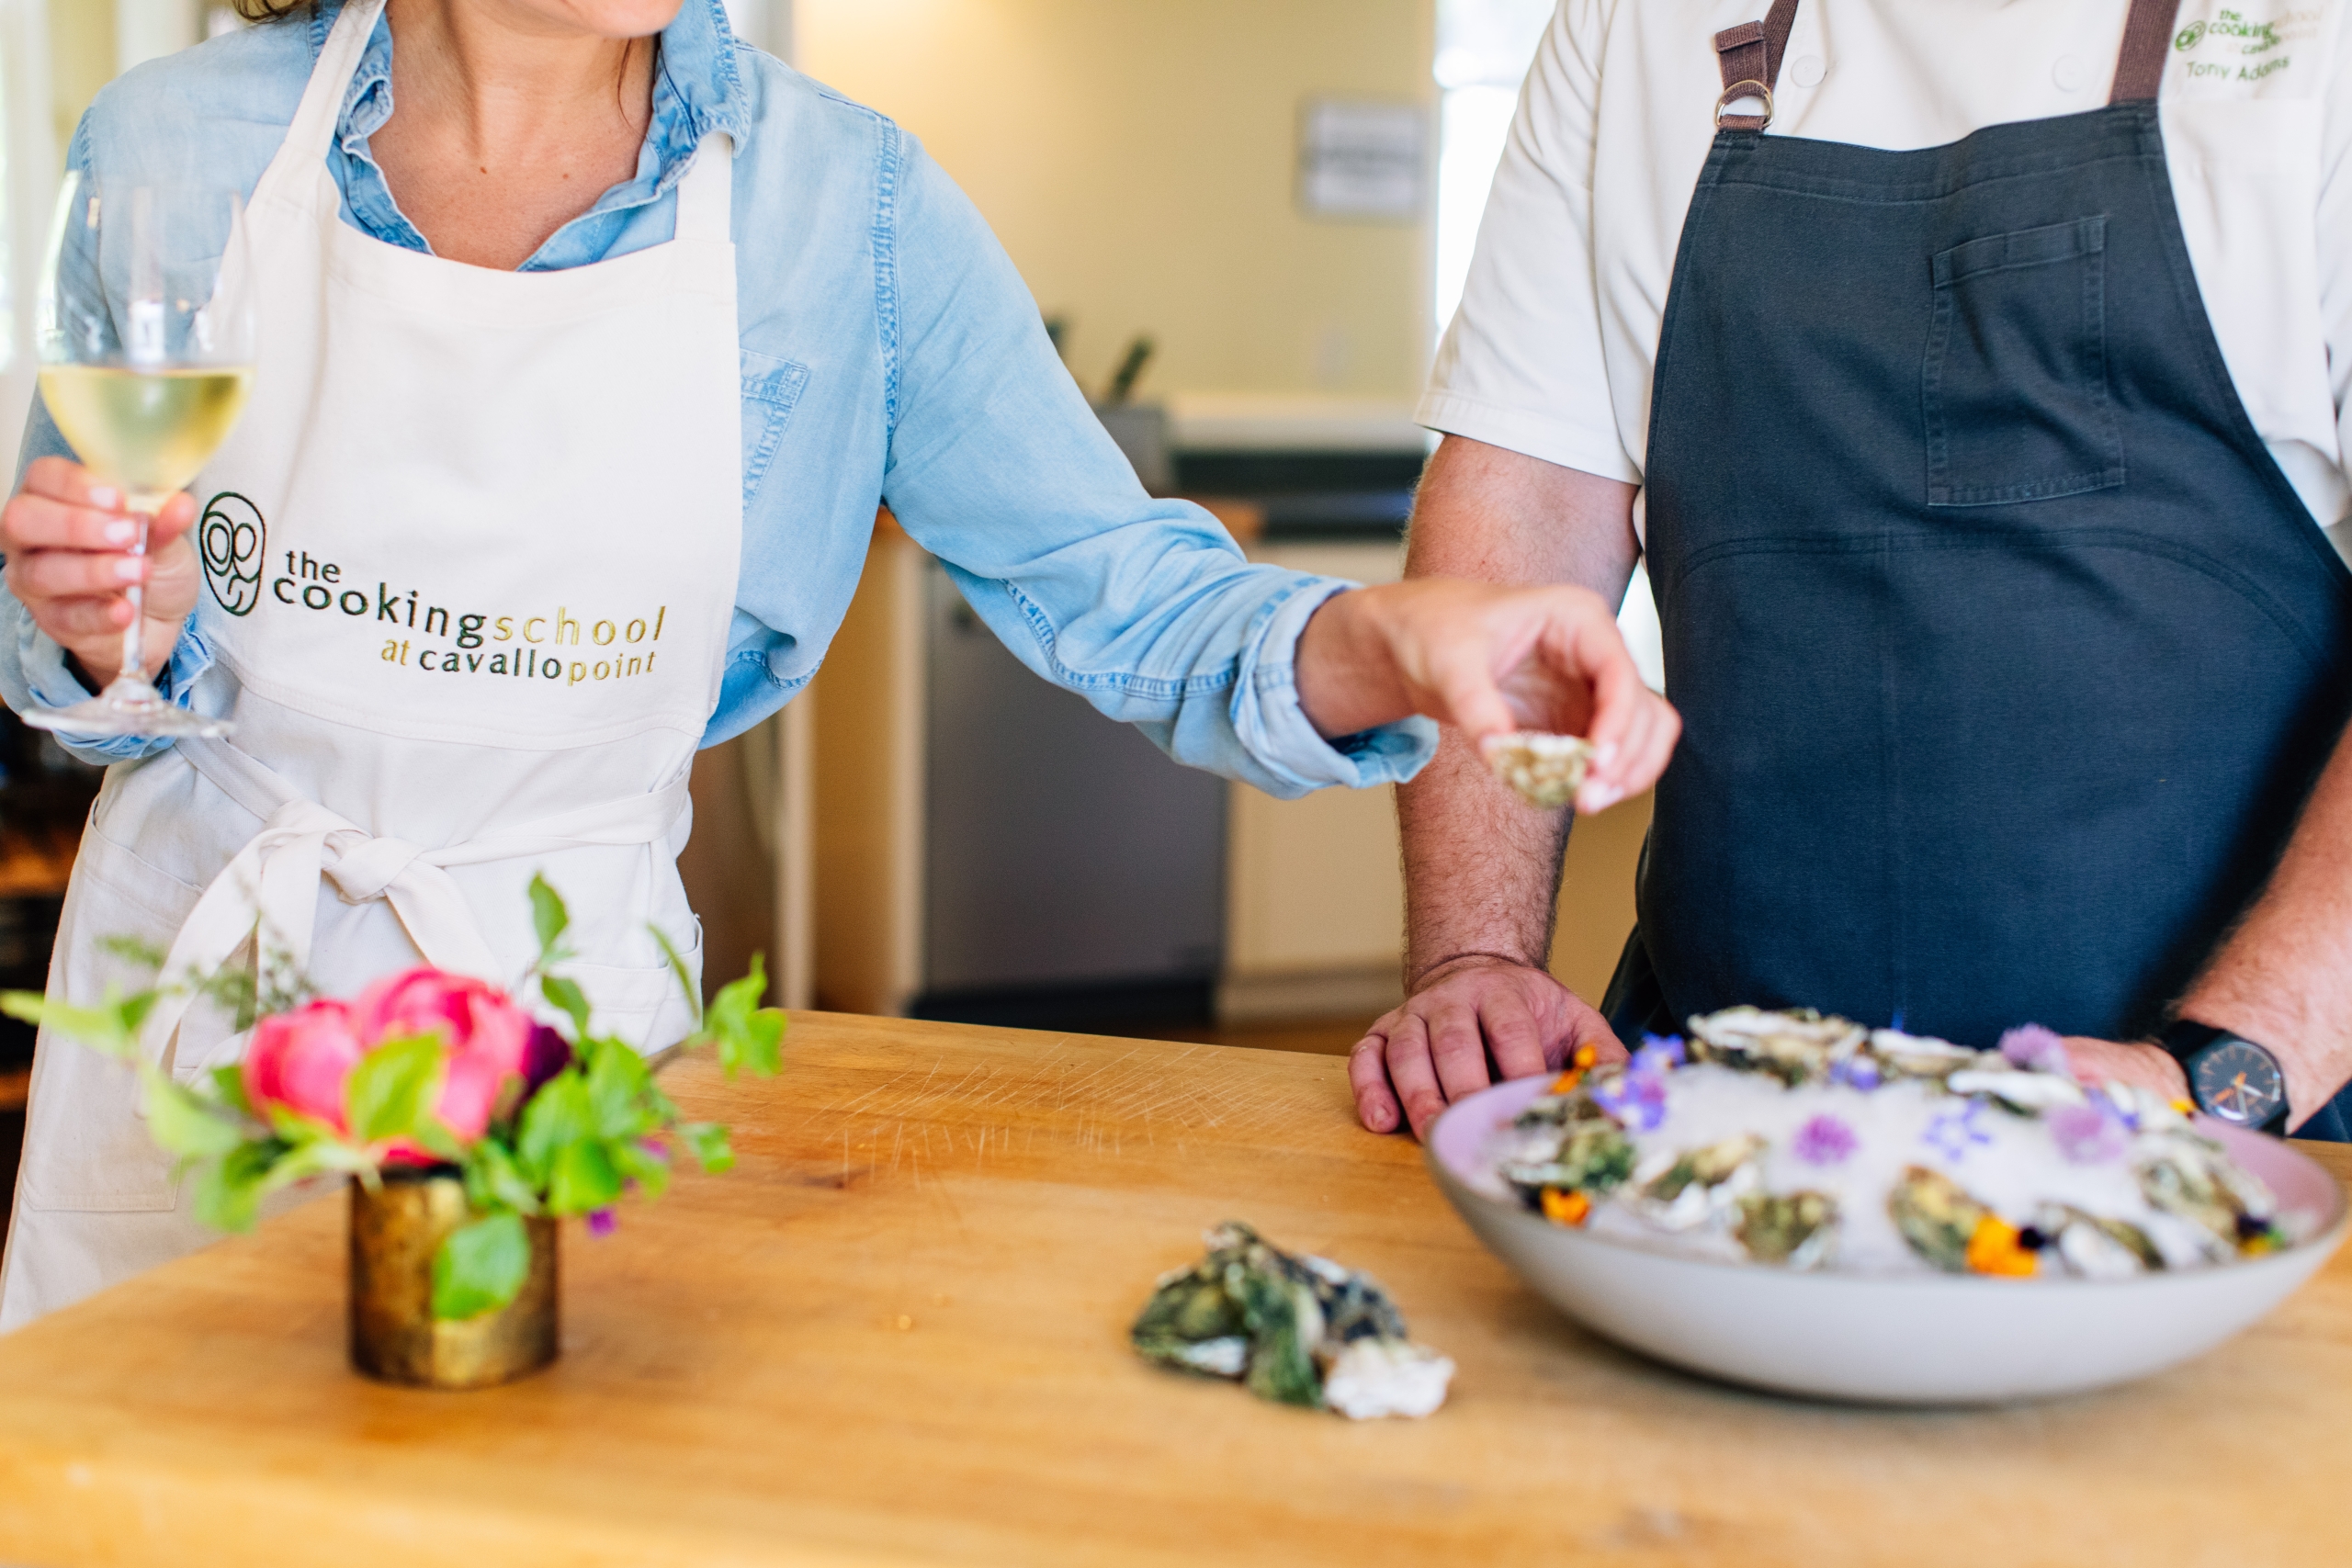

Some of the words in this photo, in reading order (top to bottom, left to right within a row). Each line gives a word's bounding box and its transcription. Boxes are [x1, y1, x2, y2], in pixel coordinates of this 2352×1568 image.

[2220, 9, 2242, 21] the
[2187, 62, 2230, 79] Tony
[2236, 56, 2290, 81] Adams
[285, 550, 341, 584] the
[381, 637, 411, 666] at
